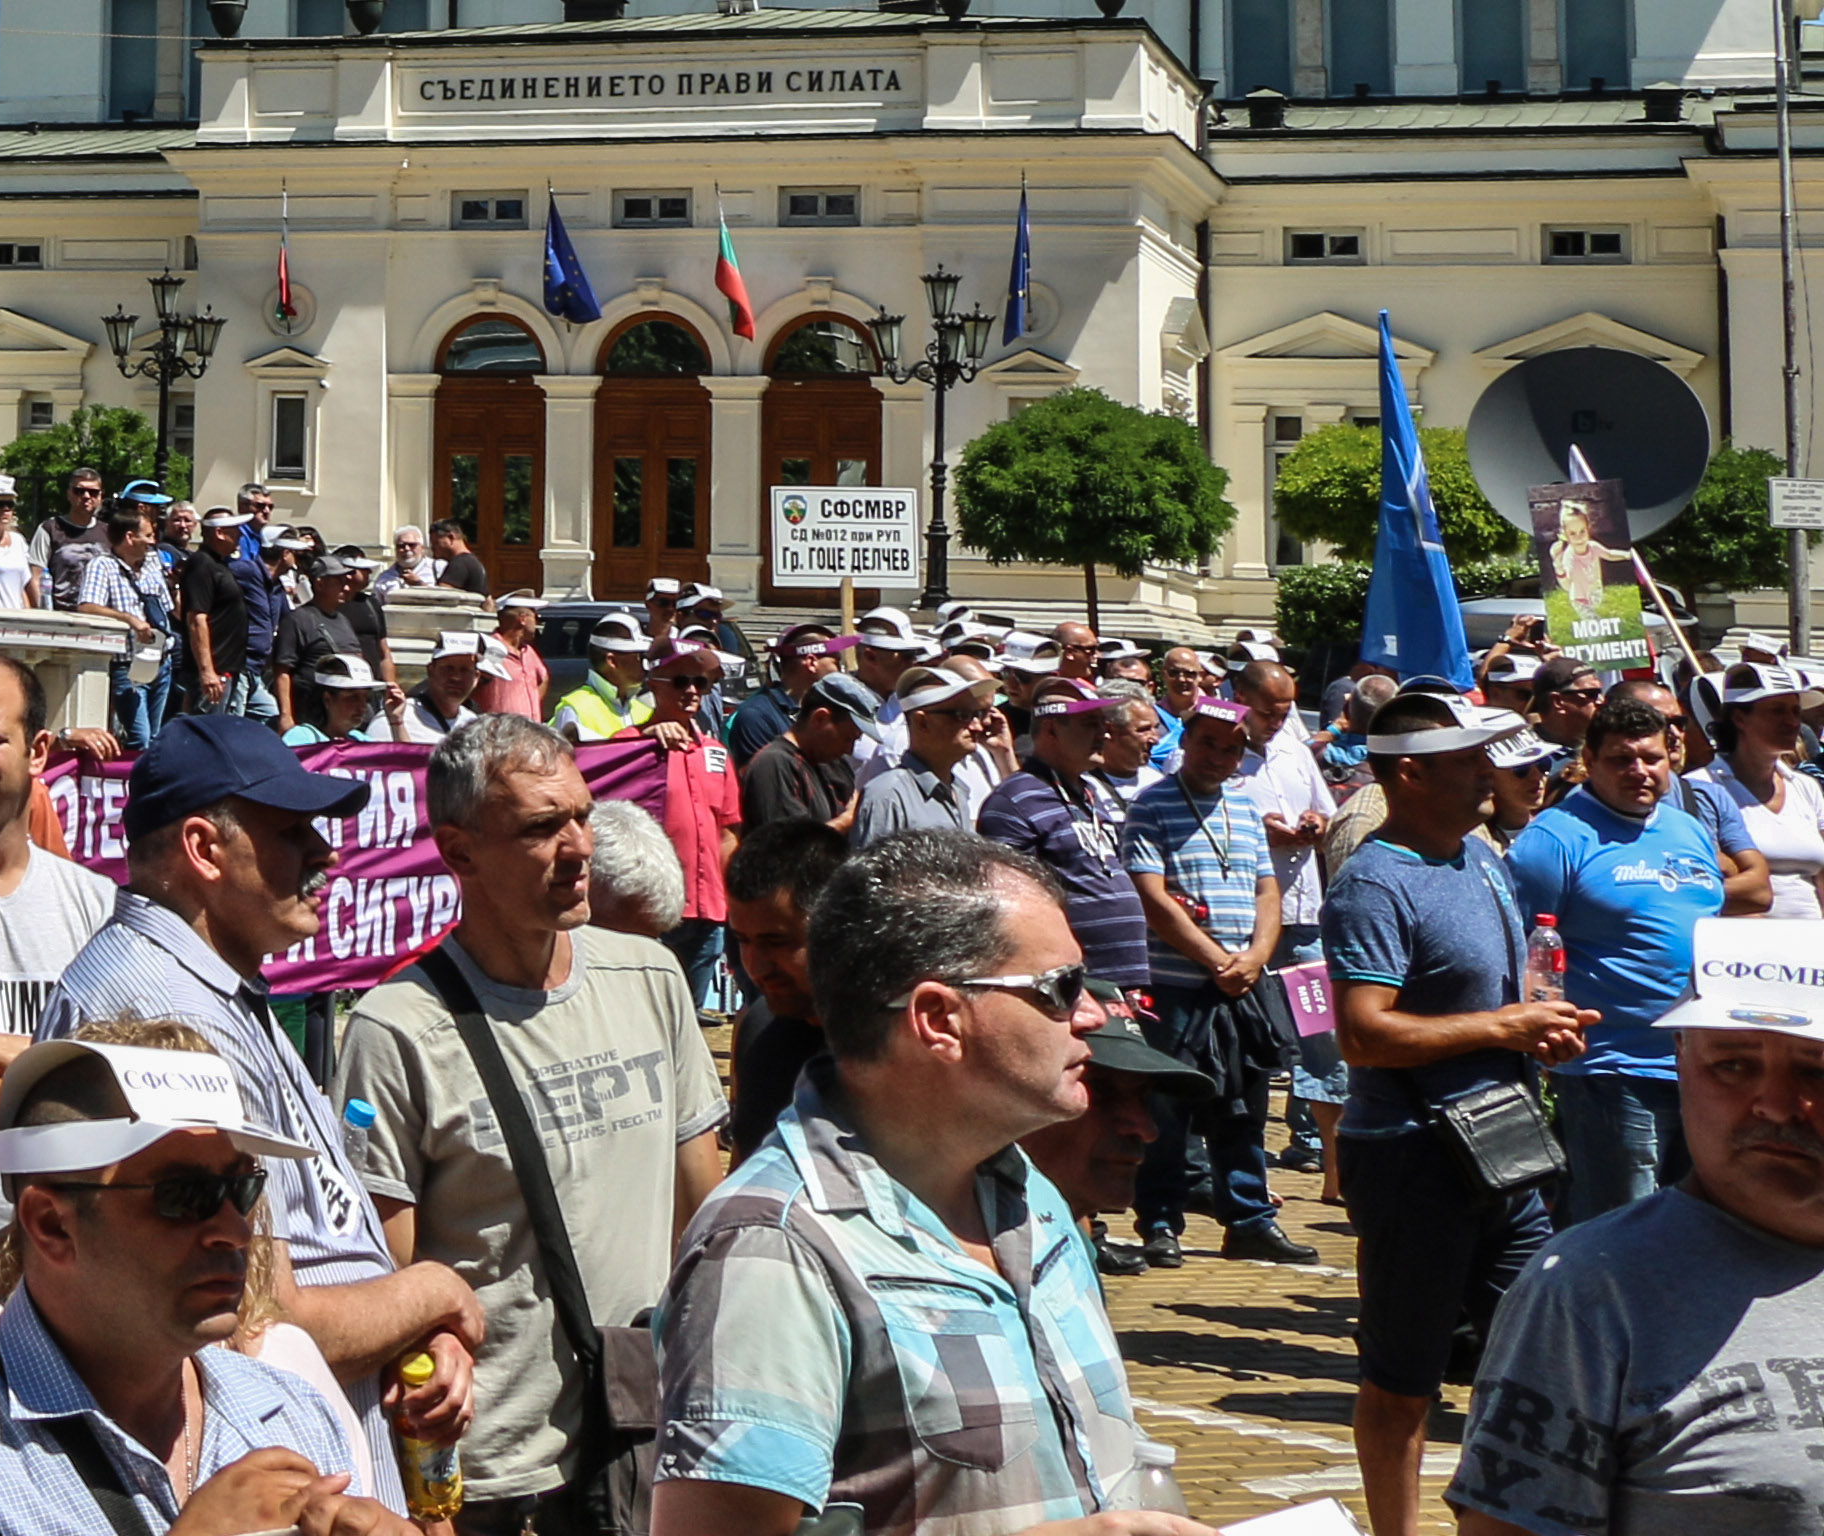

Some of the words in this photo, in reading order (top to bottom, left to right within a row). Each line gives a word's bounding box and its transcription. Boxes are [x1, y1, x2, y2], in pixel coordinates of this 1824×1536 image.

[420, 75, 664, 101] СЪЕДИНЕНИЕТО
[678, 72, 773, 95] ПРАВИ
[786, 69, 902, 94] СИЛАТА
[820, 499, 907, 519] СФСМВР
[791, 528, 808, 542] СД
[812, 528, 847, 542] №012
[851, 532, 873, 543] при
[877, 530, 901, 542] РУП
[782, 547, 804, 572] Гр.
[808, 547, 846, 573] ГОЦЕ
[851, 547, 910, 573] ДЕЛЧЕВ
[1572, 618, 1621, 639] МОЯТ
[796, 643, 827, 655] КНСБ
[1033, 702, 1067, 717] КНСБ
[1200, 704, 1236, 721] КНСБ
[327, 873, 462, 961] СИГУР
[1702, 959, 1824, 988] СФСМВ
[1297, 985, 1313, 1014] МВР
[528, 1049, 620, 1081] OPERATIVE
[123, 1068, 230, 1095] СФСМВР
